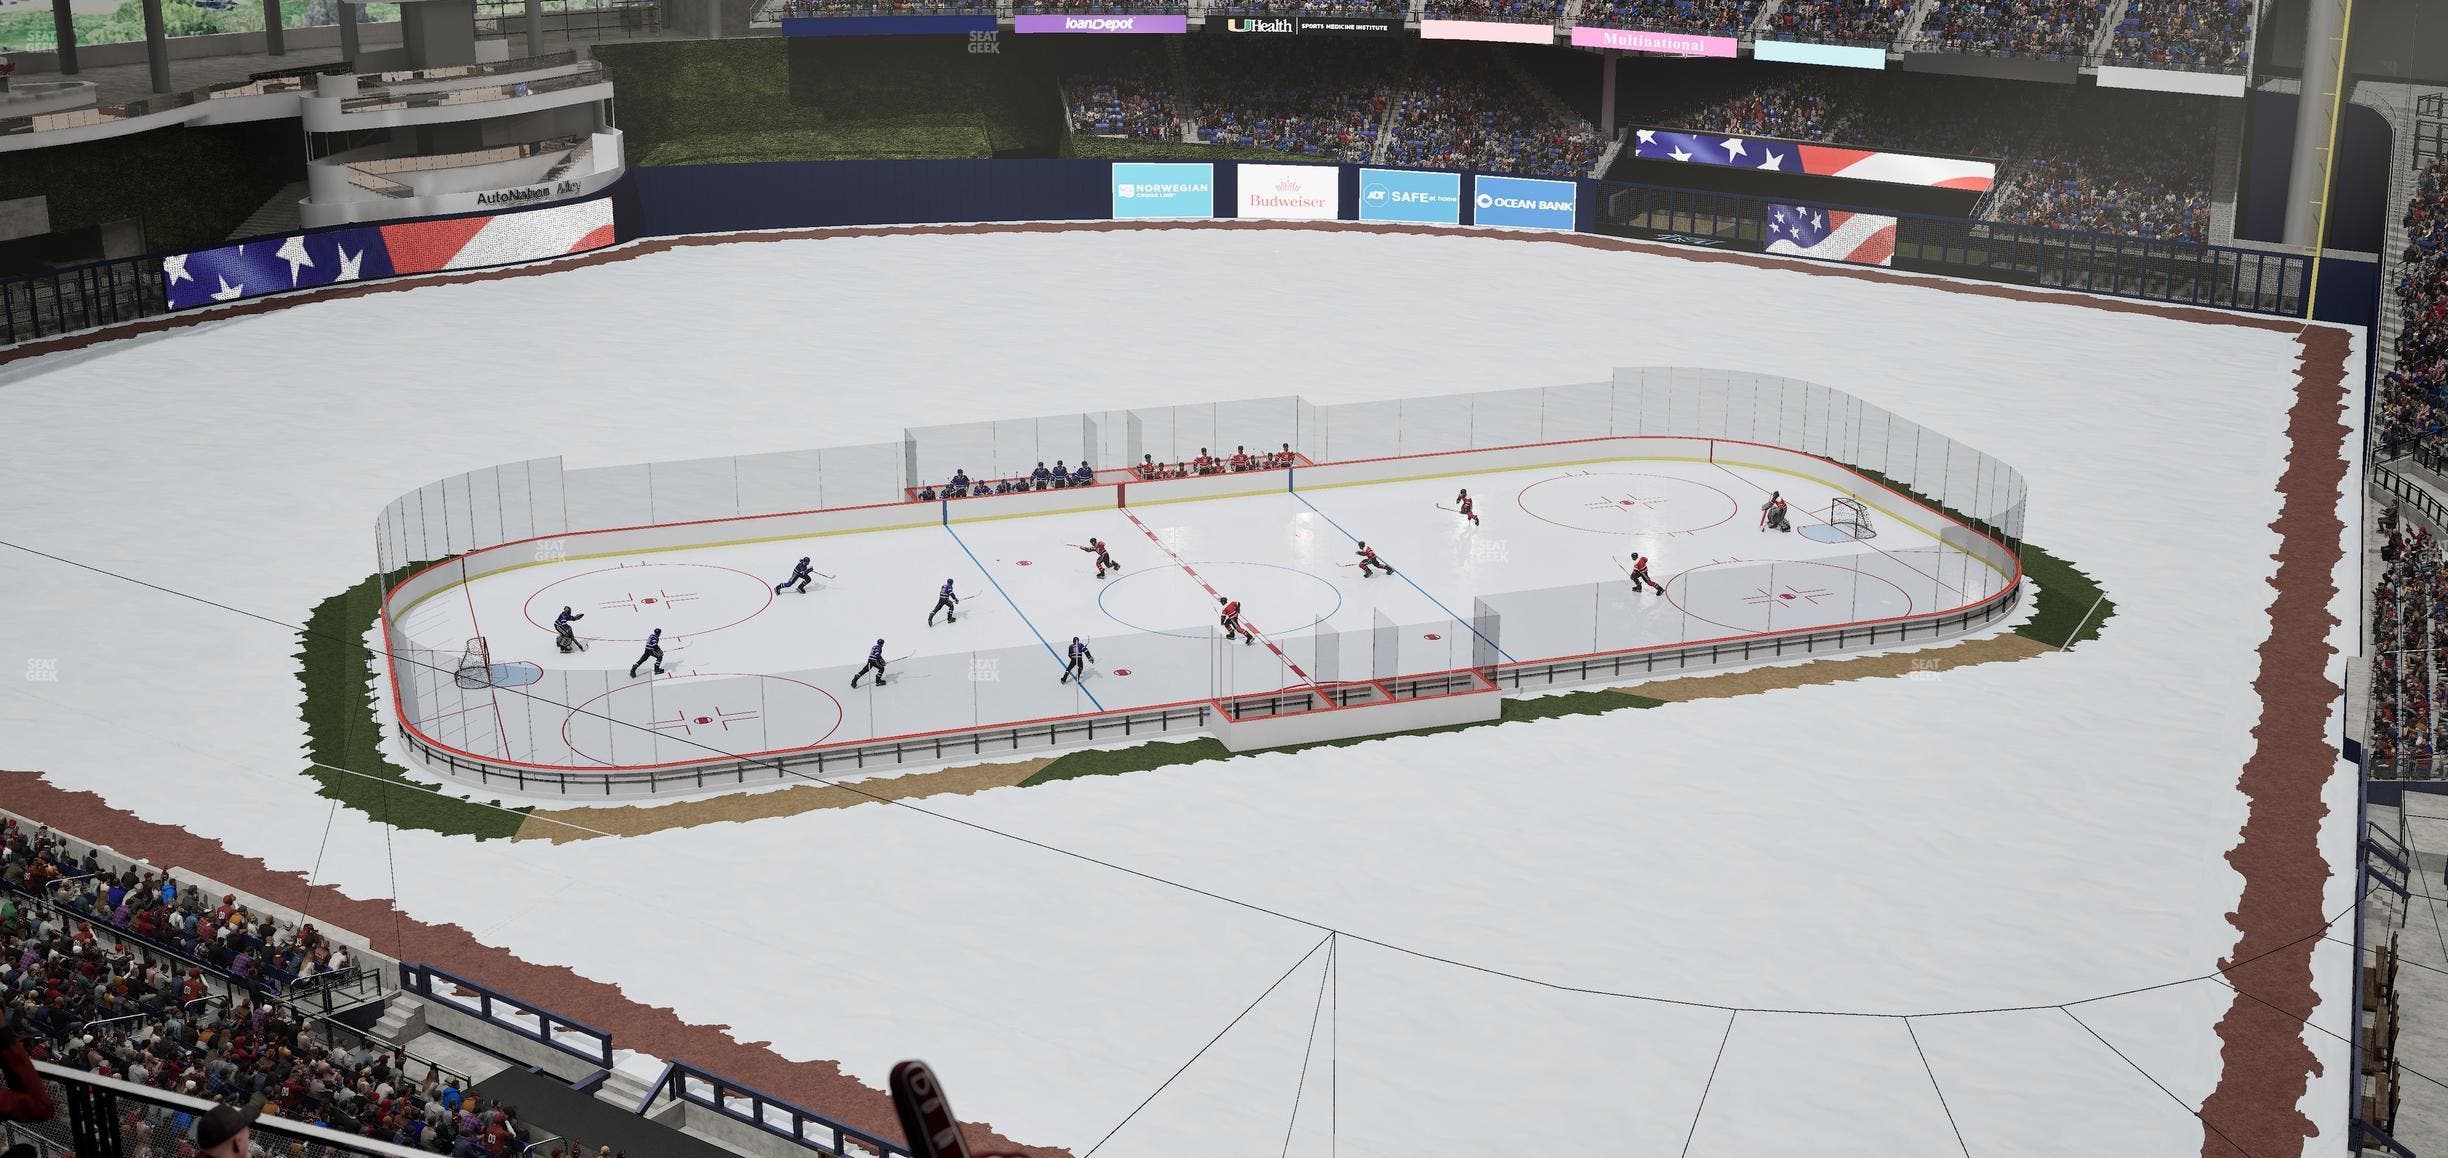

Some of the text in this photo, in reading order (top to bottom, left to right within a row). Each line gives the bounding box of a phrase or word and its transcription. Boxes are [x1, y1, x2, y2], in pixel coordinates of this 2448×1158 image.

[1301, 22, 1324, 30] SPORTS
[1326, 23, 1354, 31] MEDICINE
[1356, 24, 1388, 32] INSTITUTE
[1603, 31, 1705, 52] Multinational
[1136, 183, 1208, 193] NORWEGIAN
[1250, 194, 1326, 208] Budweiser
[1391, 191, 1429, 203] SAFE
[1494, 198, 1573, 211] OCEAN BANK
